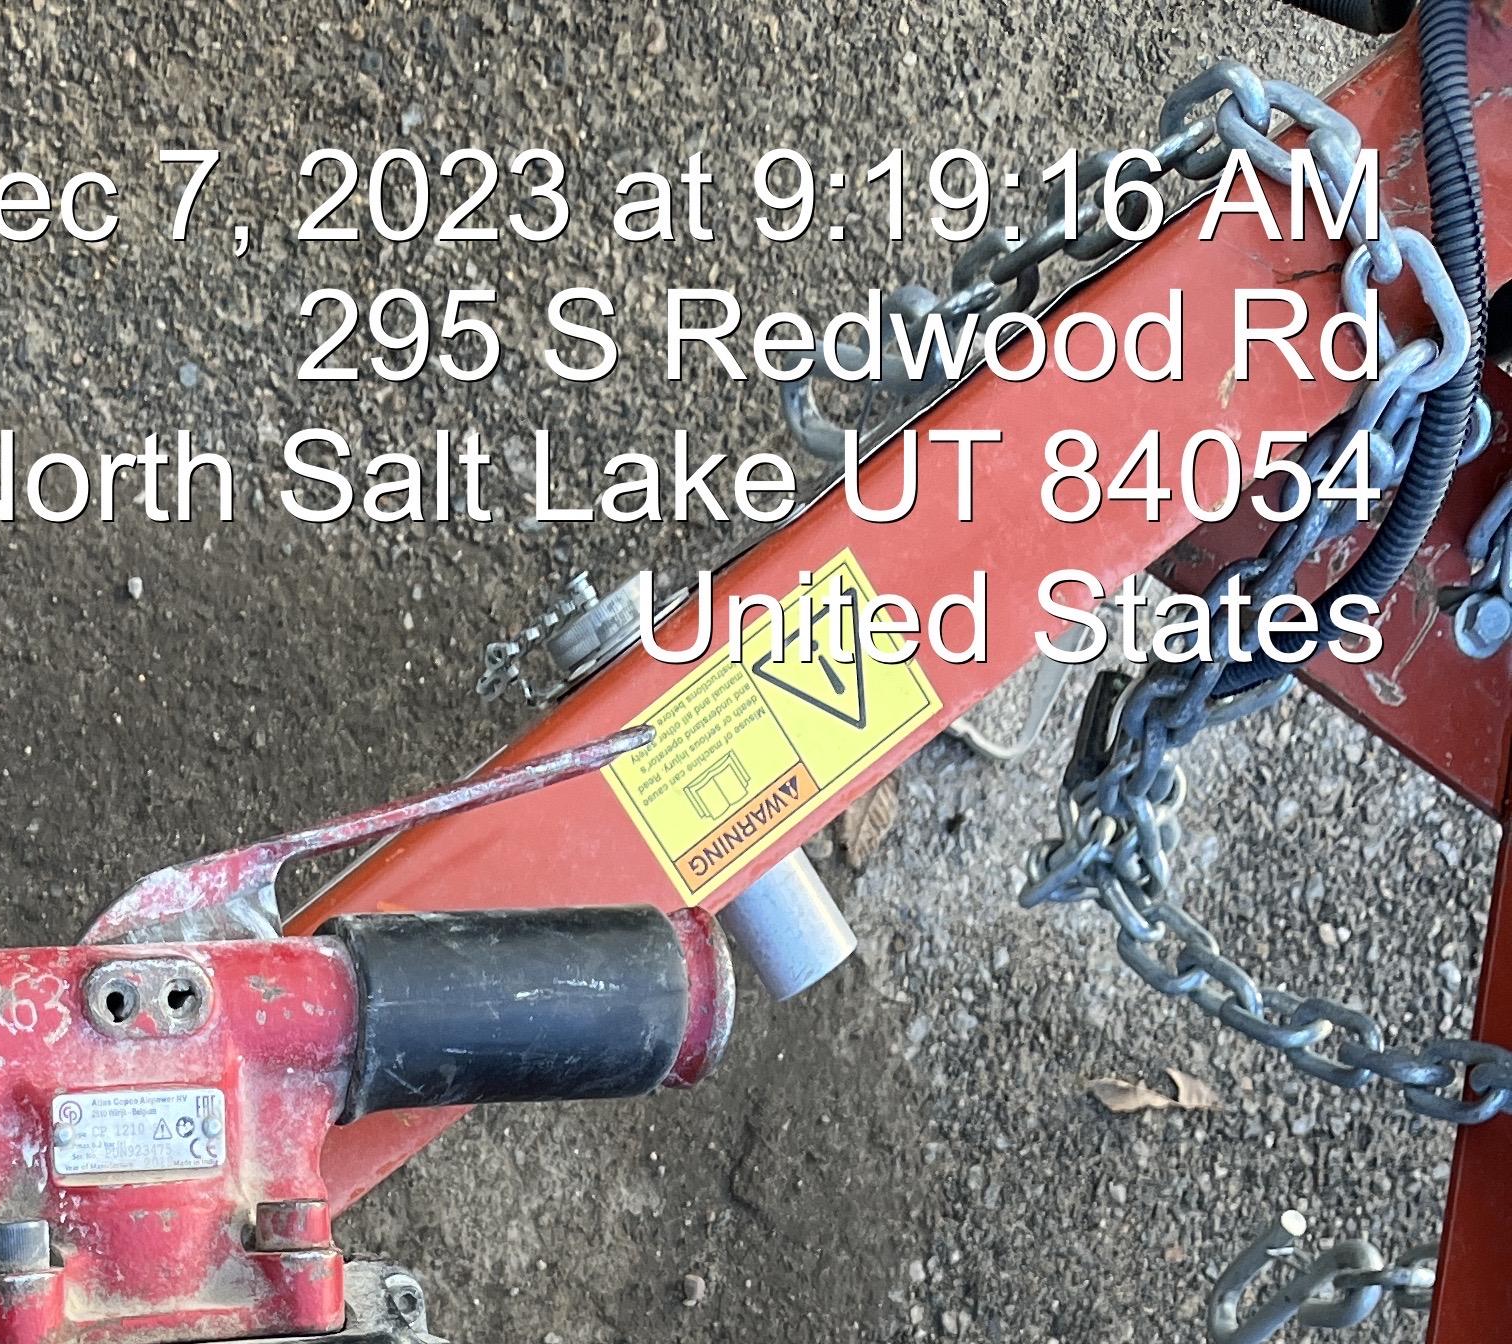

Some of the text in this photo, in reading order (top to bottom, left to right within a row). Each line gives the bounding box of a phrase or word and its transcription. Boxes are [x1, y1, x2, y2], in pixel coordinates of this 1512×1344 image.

[712, 672, 743, 701] manual
[657, 701, 686, 726] before
[694, 697, 710, 715] and
[733, 695, 757, 717] death
[640, 683, 750, 773] and understand operator's
[682, 712, 692, 725] all
[723, 716, 731, 726] or
[659, 722, 680, 742] other
[689, 724, 721, 751] serious
[643, 706, 766, 806] Misuse of machine can cause
[638, 773, 661, 795] Read
[689, 794, 788, 875] WARNING
